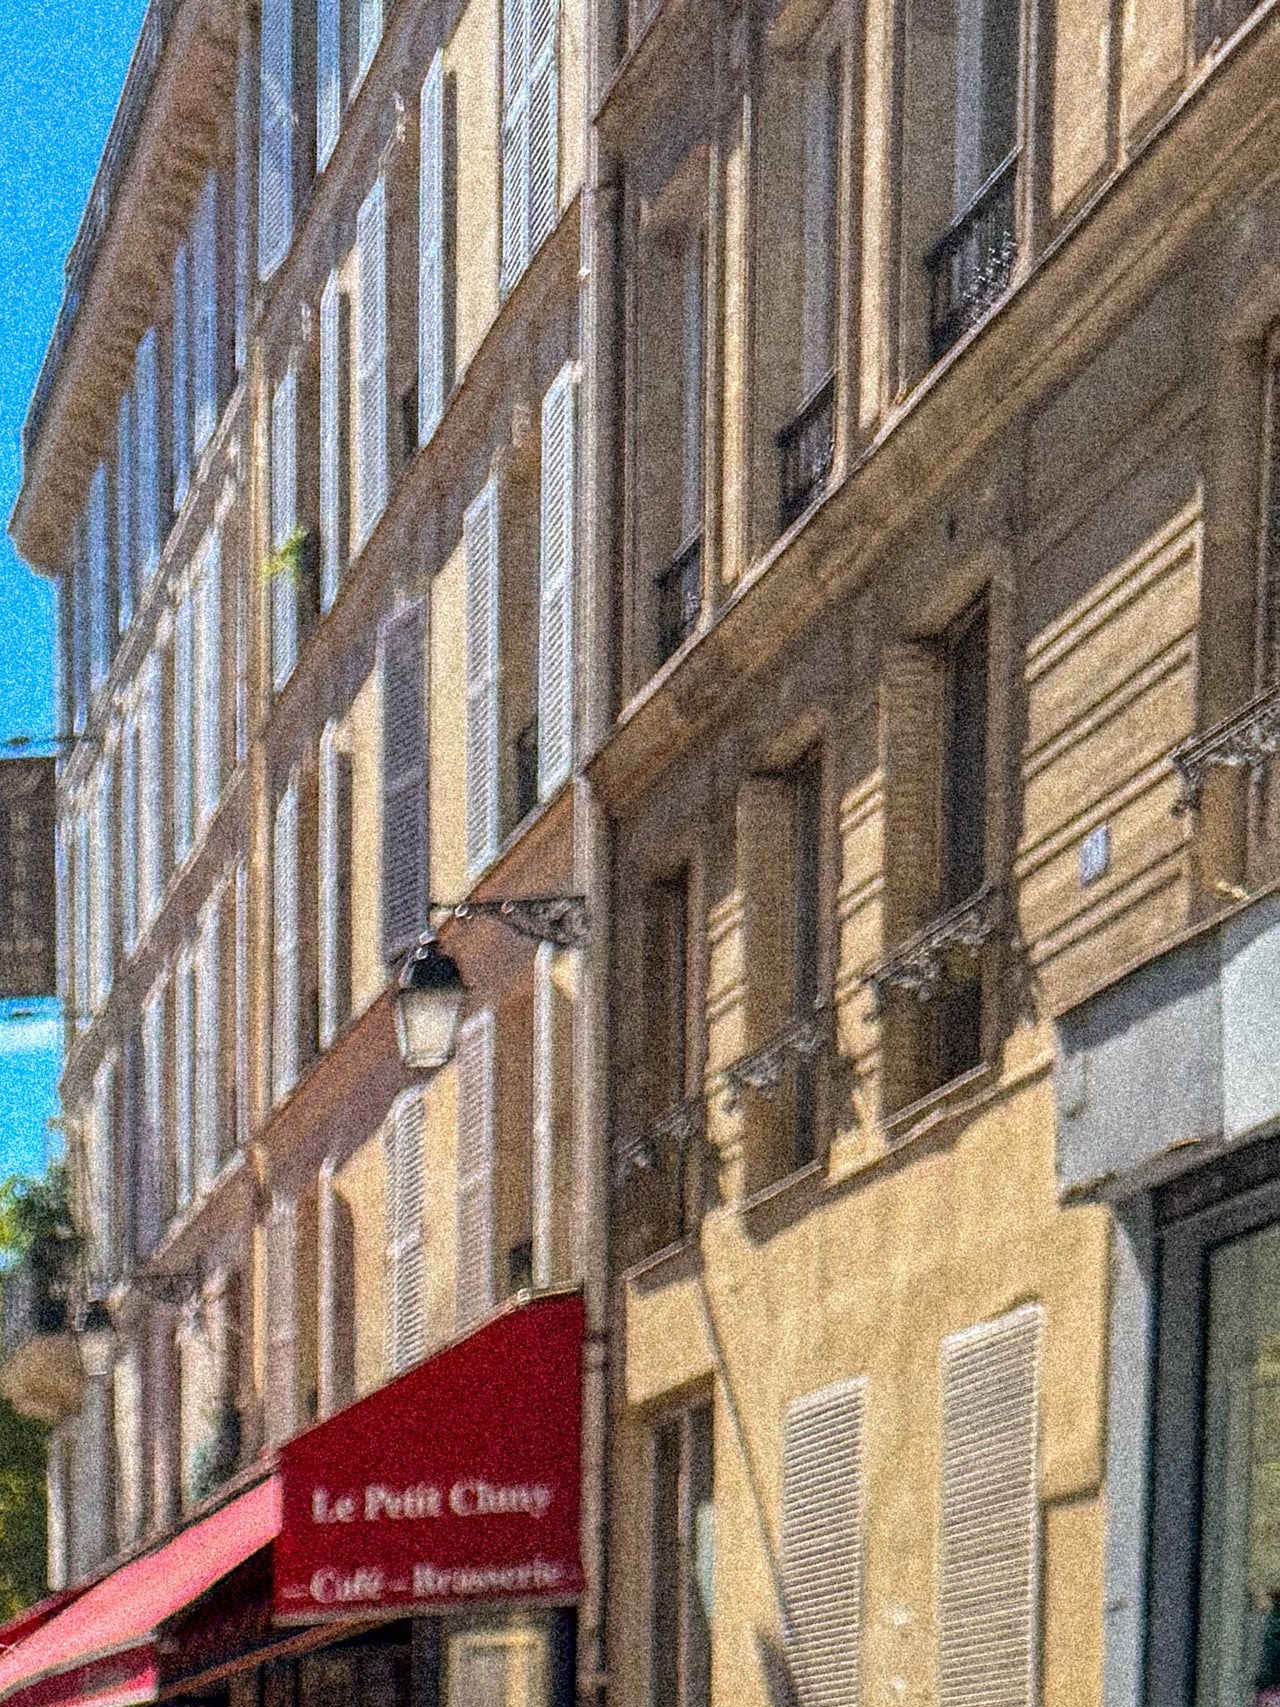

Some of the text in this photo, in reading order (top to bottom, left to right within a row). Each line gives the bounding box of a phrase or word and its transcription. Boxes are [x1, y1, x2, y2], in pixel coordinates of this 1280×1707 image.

[312, 1477, 552, 1524] Le Petit Cluny
[310, 1566, 384, 1603] Café
